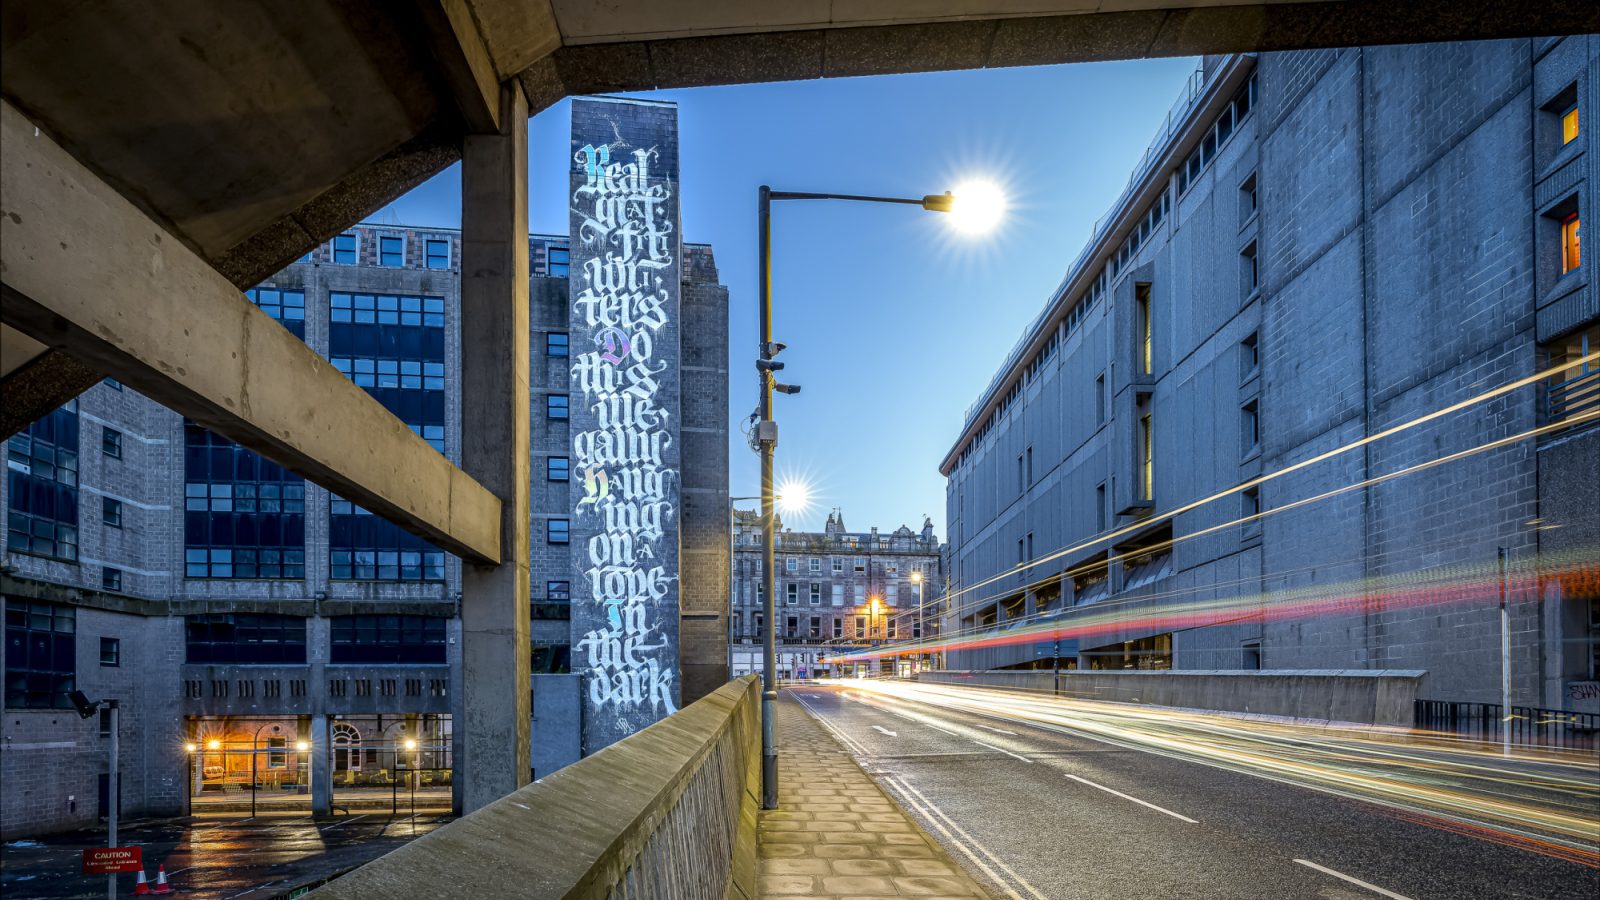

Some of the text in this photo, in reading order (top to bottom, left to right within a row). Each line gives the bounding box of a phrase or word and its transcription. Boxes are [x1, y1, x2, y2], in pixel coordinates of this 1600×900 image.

[574, 144, 659, 202] Real
[575, 626, 669, 671] the
[586, 657, 679, 716] dark
[94, 851, 132, 859] CAUTION
